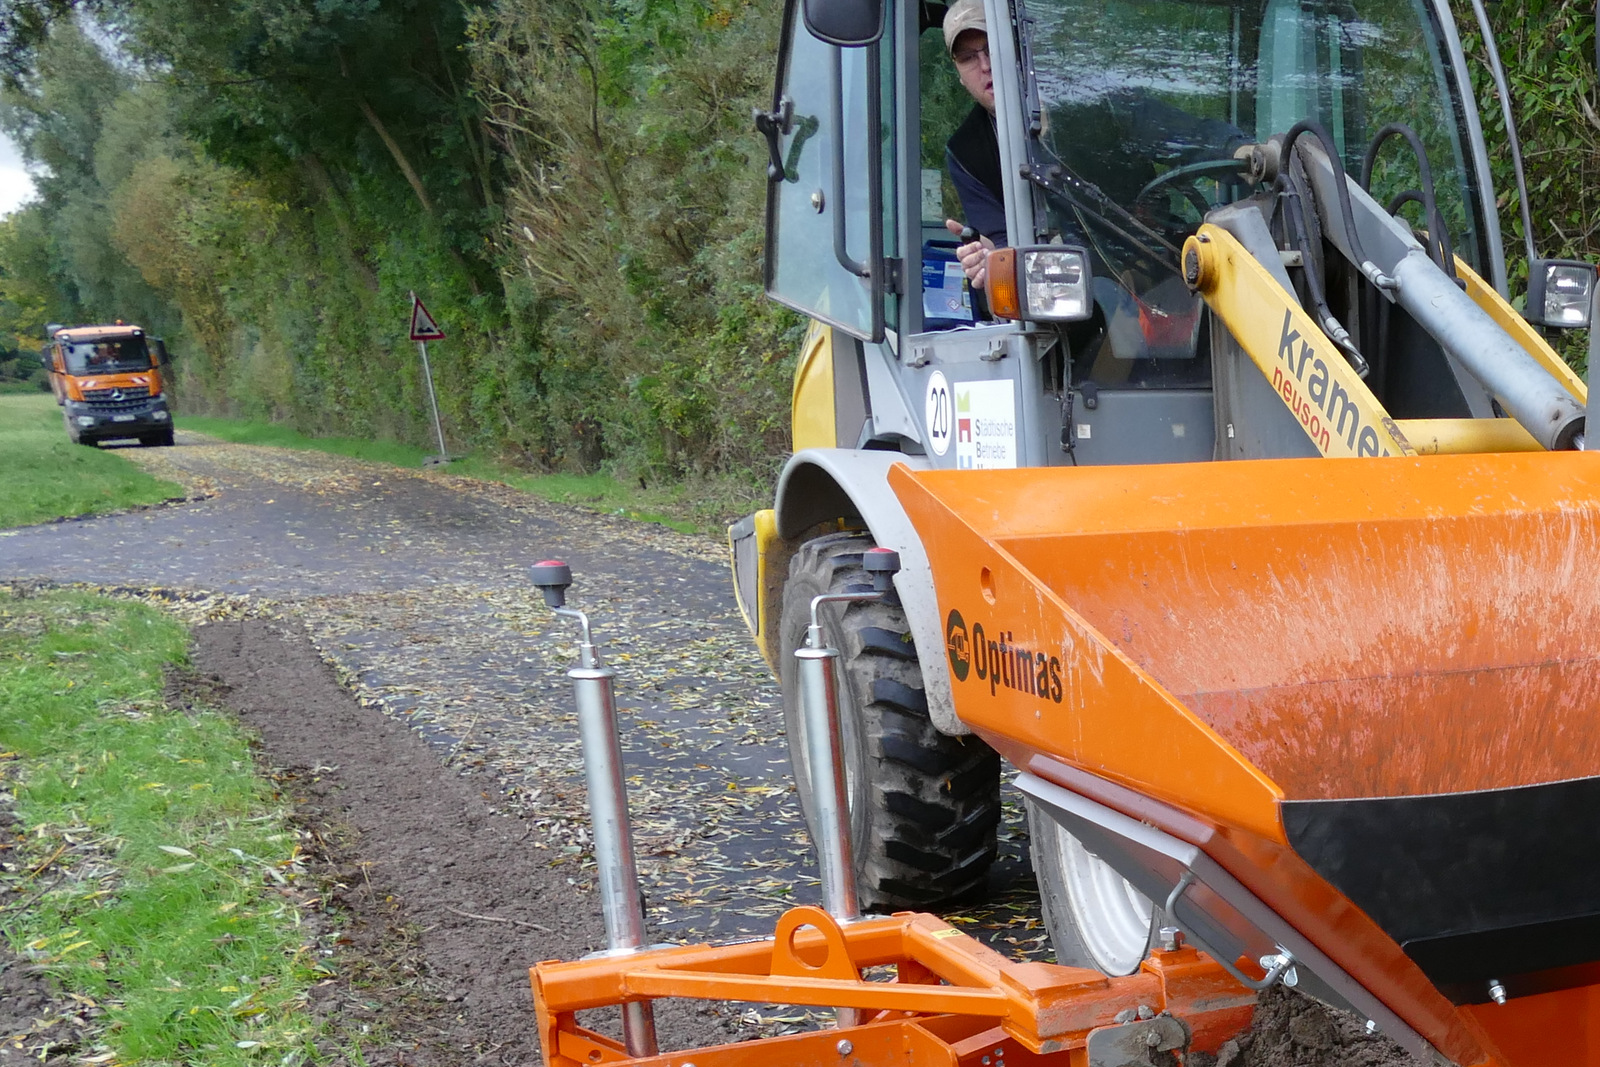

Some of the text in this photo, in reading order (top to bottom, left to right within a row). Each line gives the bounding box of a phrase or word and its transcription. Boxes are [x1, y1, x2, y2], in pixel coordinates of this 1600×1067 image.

[930, 386, 948, 440] 20
[1272, 365, 1331, 454] neuson
[1277, 306, 1391, 458] krame
[974, 417, 1014, 438] Städtische
[975, 440, 1007, 460] Betriebe
[972, 621, 1063, 704] Optimas
